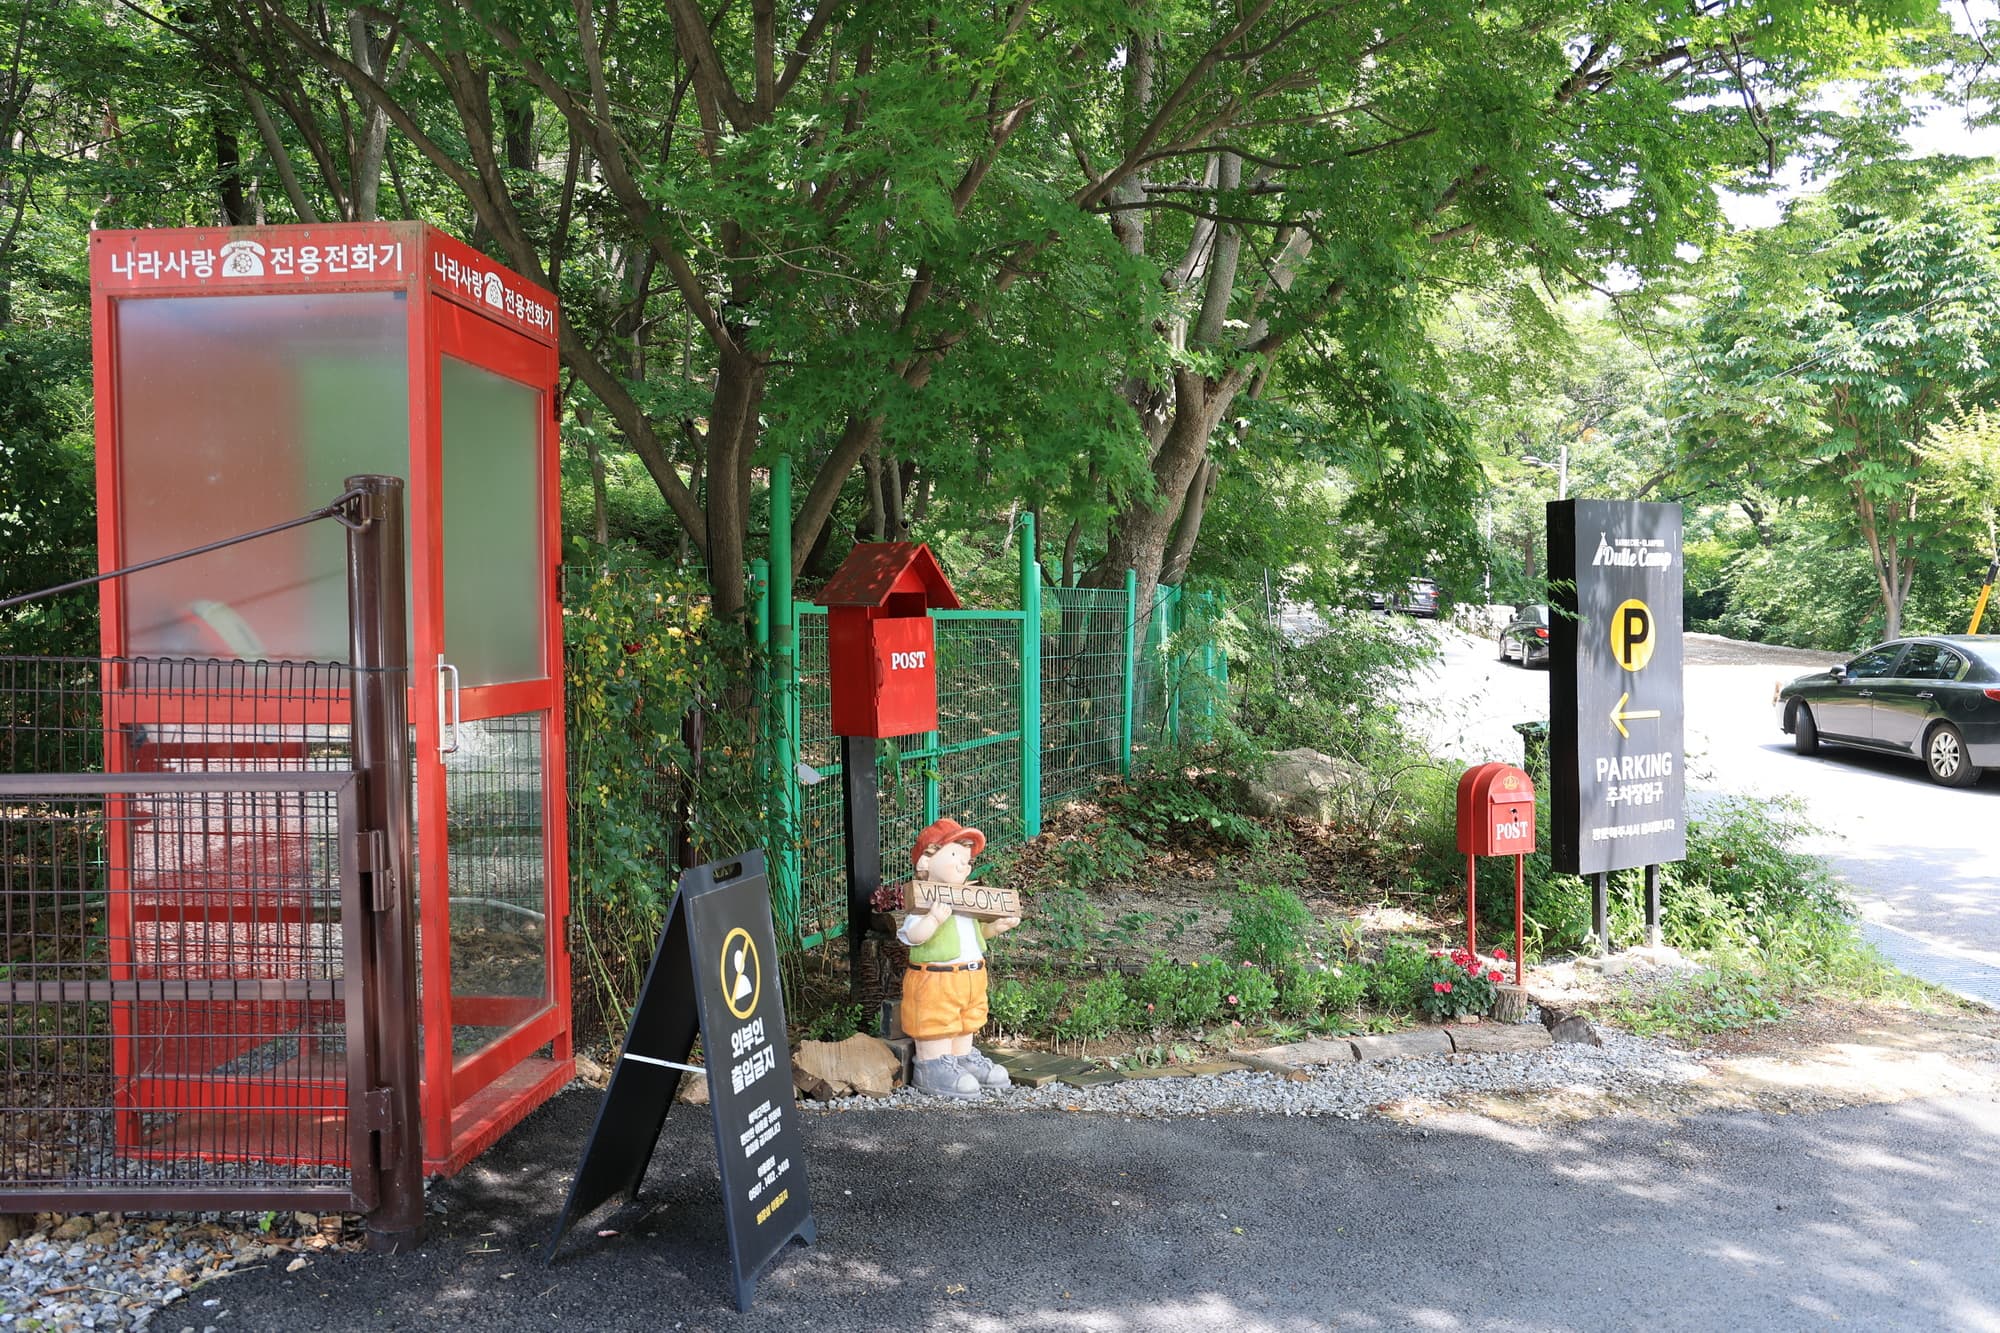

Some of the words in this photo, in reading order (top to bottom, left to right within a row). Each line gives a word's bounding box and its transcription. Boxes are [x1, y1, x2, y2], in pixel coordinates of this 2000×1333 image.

[111, 248, 216, 280] 나라사랑
[270, 242, 403, 275] 전용전화기
[434, 251, 483, 299] 나라사랑
[505, 288, 553, 334] 전용전화기
[1623, 608, 1650, 664] P
[891, 651, 926, 671] POST
[1596, 752, 1673, 783] PARKING
[1606, 781, 1664, 808] 주차장입구
[1496, 821, 1528, 840] POST
[918, 883, 1016, 912] WELCOME
[731, 1017, 765, 1058] 외부인
[731, 1045, 775, 1095] 출입금지
